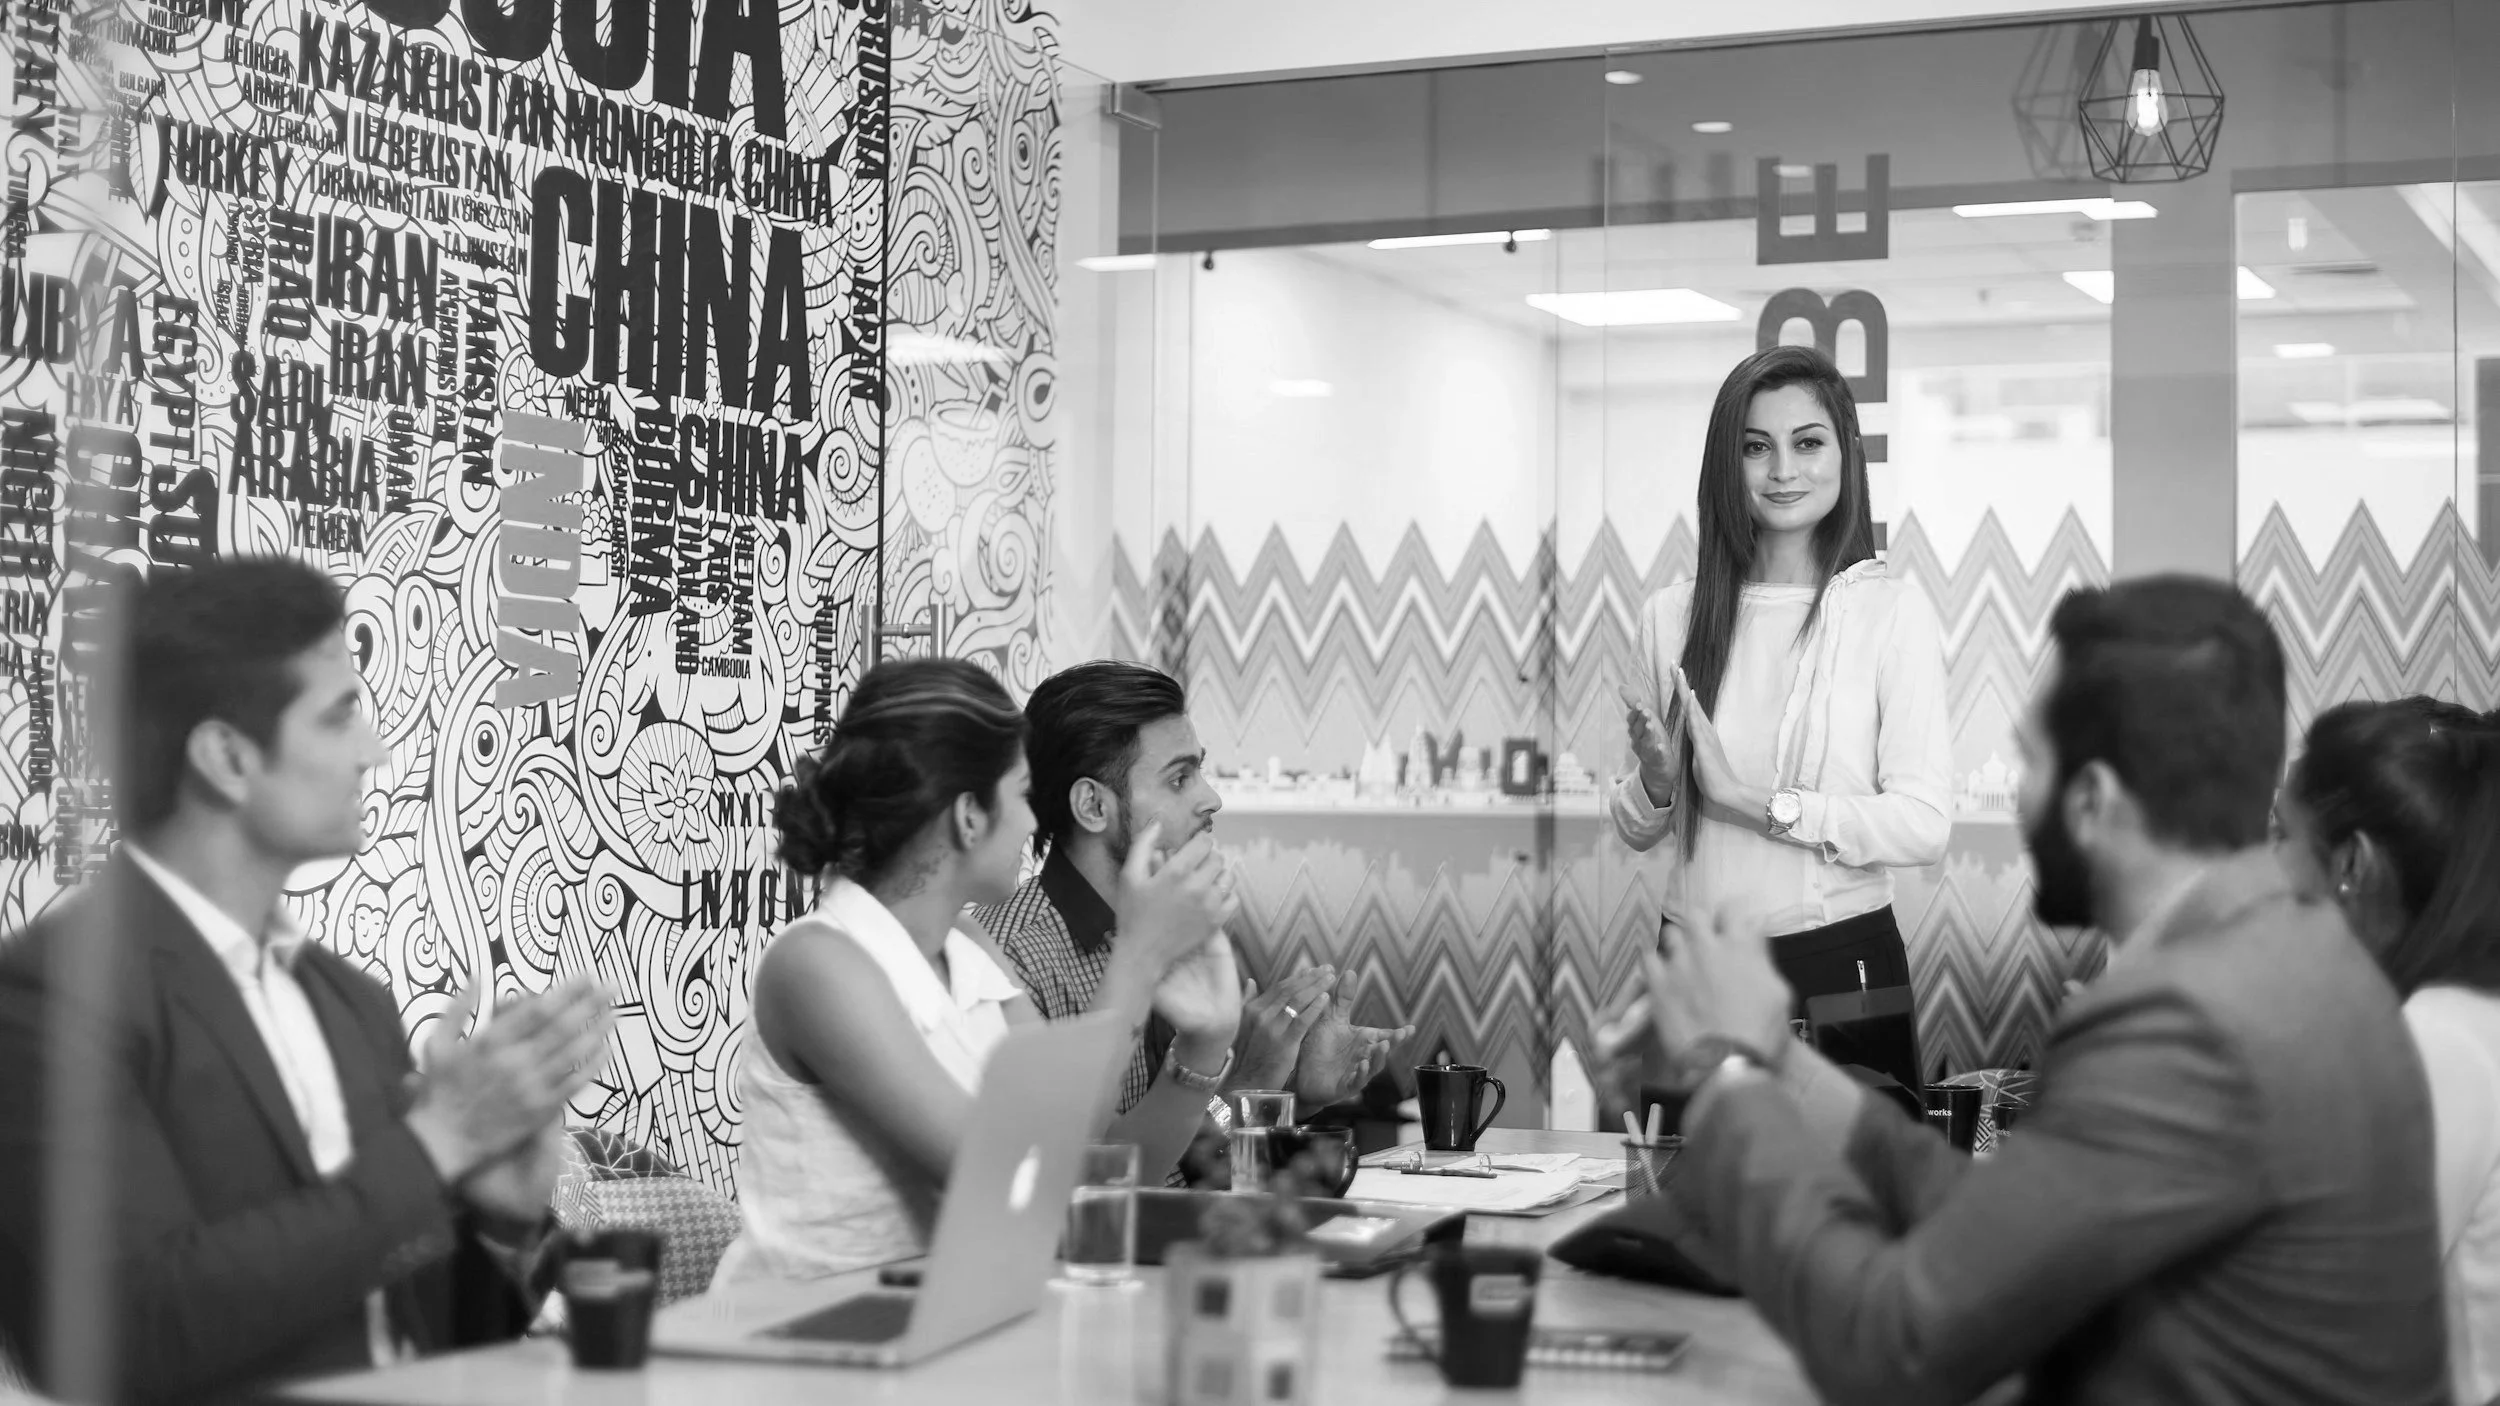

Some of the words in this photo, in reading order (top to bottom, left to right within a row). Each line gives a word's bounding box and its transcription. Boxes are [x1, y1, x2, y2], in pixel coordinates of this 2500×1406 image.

[224, 34, 291, 80] GEORGIA
[243, 72, 317, 119] ARMENIA
[857, 19, 888, 181] RUSSIA
[156, 112, 293, 207] TURKEY
[300, 8, 555, 152] KAZAKHSTAN
[565, 90, 736, 202] MONGOLIA
[744, 139, 834, 228] CHINA
[353, 110, 512, 201] UZBEKISTAN
[309, 158, 449, 225] TURKMENISTAN
[452, 194, 531, 236] KYRGYZSTAN
[262, 198, 315, 342] IRAQ
[316, 211, 438, 328] IRAN
[528, 165, 813, 422] CHINA
[149, 292, 200, 461] EGYPT
[330, 319, 428, 409] IRAN
[462, 279, 498, 486] PAKISTAN
[850, 266, 883, 403] JAPAN
[228, 414, 380, 512] ARABIA
[384, 410, 414, 513] OMAN
[629, 406, 678, 618] BURMA
[678, 413, 805, 524] CHINA
[290, 508, 364, 553] YEMEN
[494, 410, 585, 711] INDIA
[733, 522, 755, 655] VIETNAM
[701, 656, 752, 680] CAMBODIA
